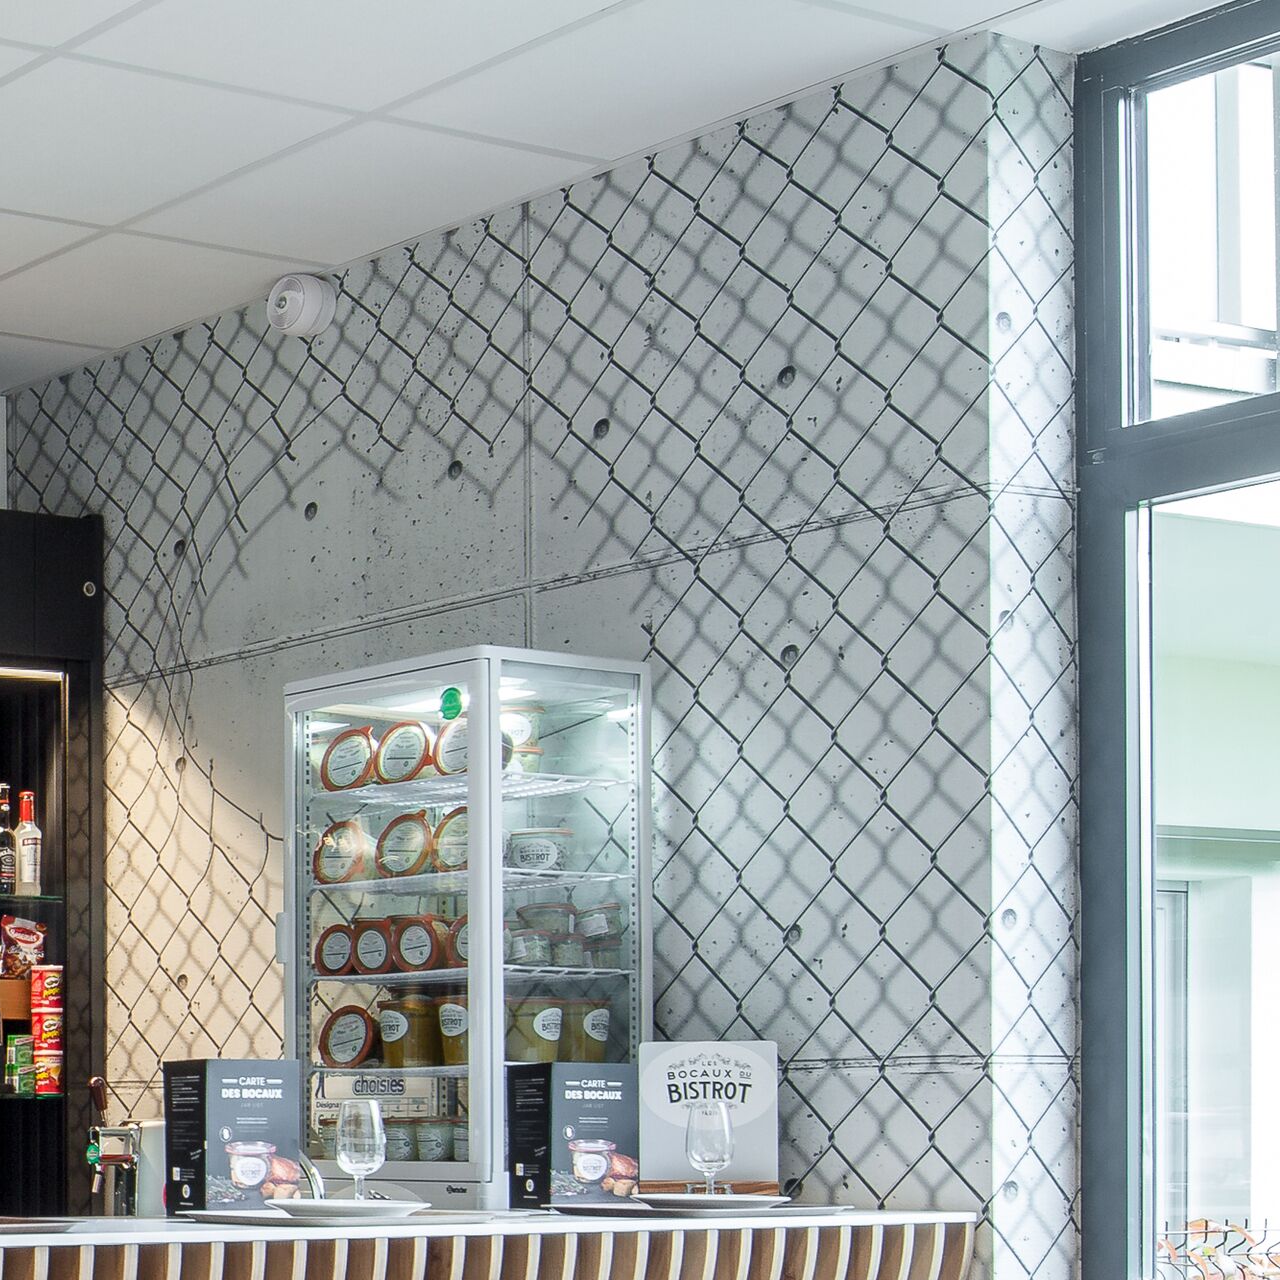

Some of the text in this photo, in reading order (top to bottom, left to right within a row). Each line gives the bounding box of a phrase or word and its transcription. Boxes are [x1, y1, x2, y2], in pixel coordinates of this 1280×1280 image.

[666, 1069, 752, 1080] BOCAUX DU
[239, 1076, 266, 1086] CARTE
[353, 1074, 406, 1094] choisies
[580, 1079, 606, 1088] CARTE
[221, 1089, 283, 1099] DES BOCAUX
[565, 1090, 622, 1100] DES BOCAUX
[667, 1081, 753, 1104] BISTROT
